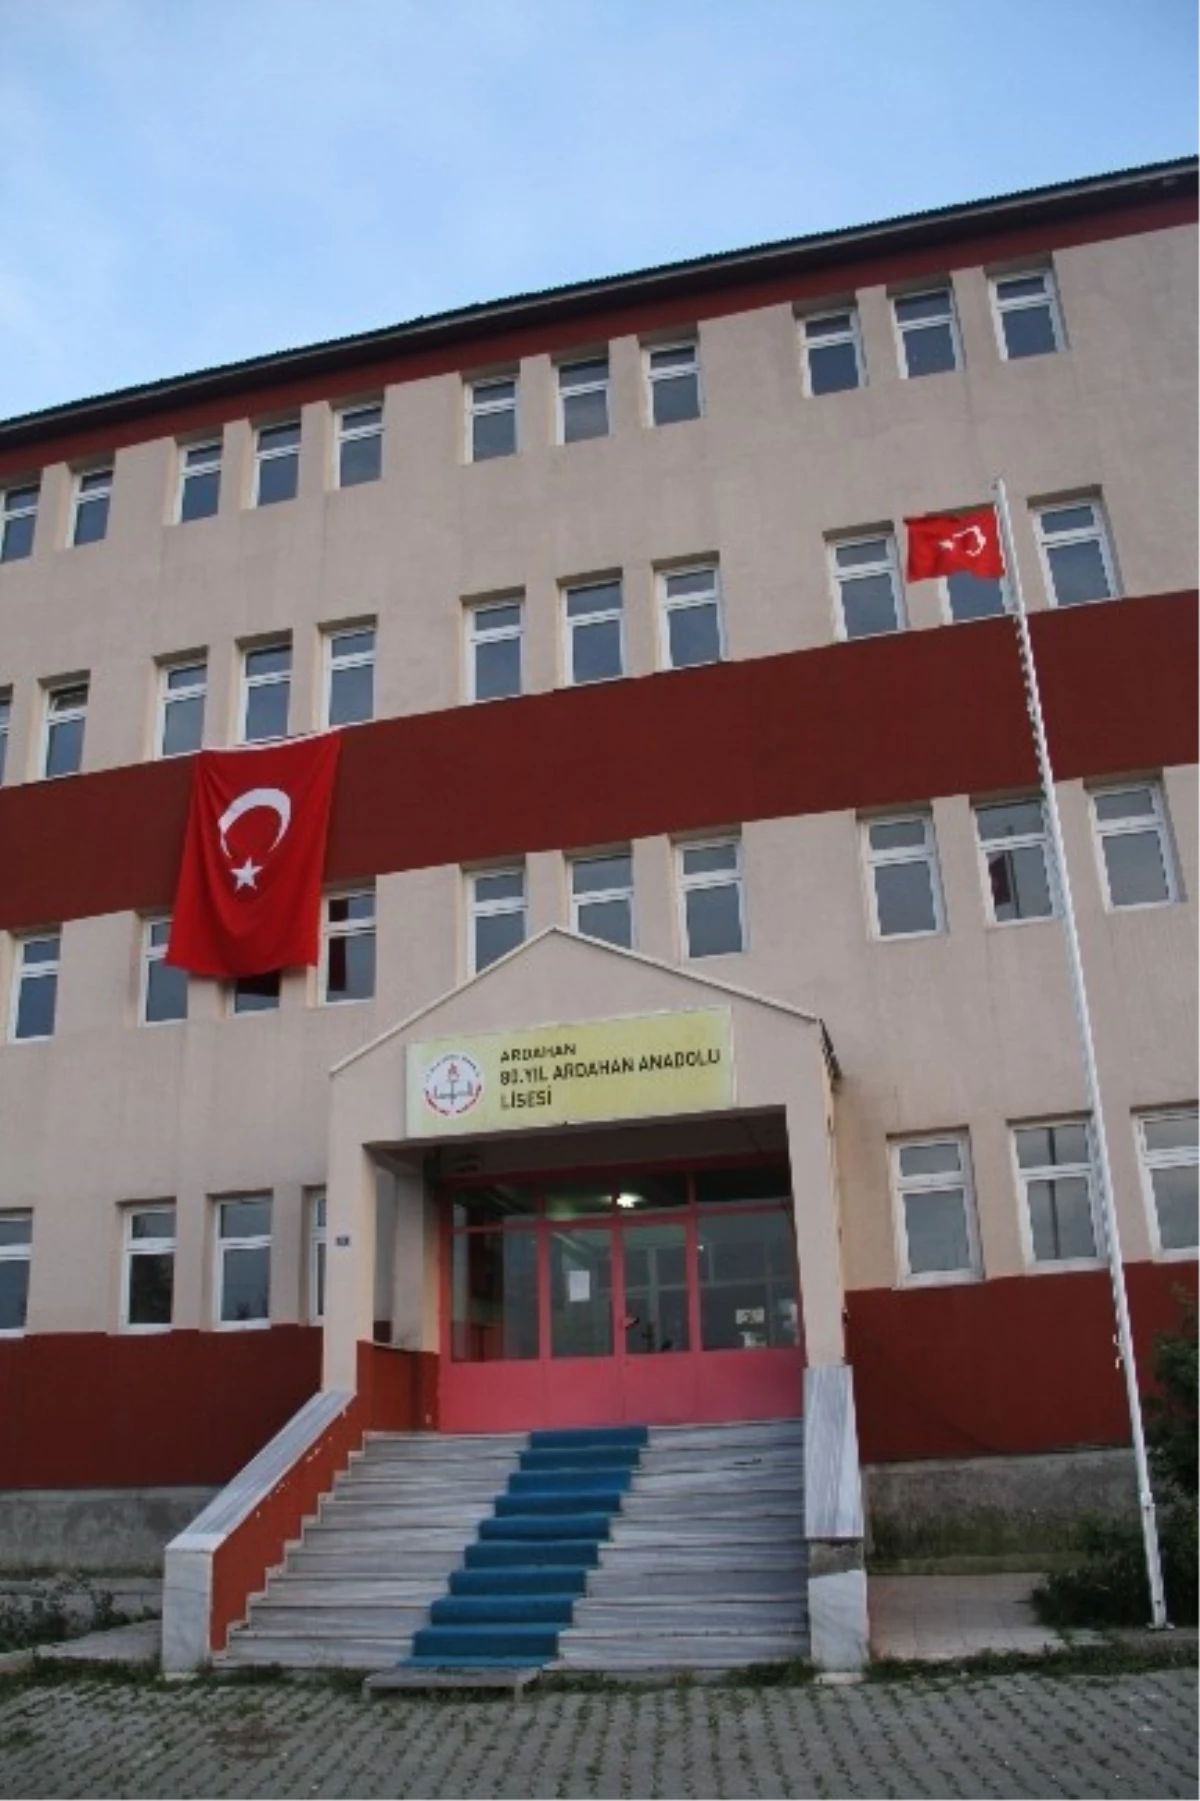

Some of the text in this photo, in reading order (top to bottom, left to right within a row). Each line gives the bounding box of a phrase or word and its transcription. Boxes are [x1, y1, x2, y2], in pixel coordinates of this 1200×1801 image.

[500, 1043, 576, 1062] ARDAHAN
[553, 1059, 634, 1080] ARDAHAN
[639, 1049, 721, 1071] ANADOLU
[500, 1086, 552, 1109] LİSESİ
